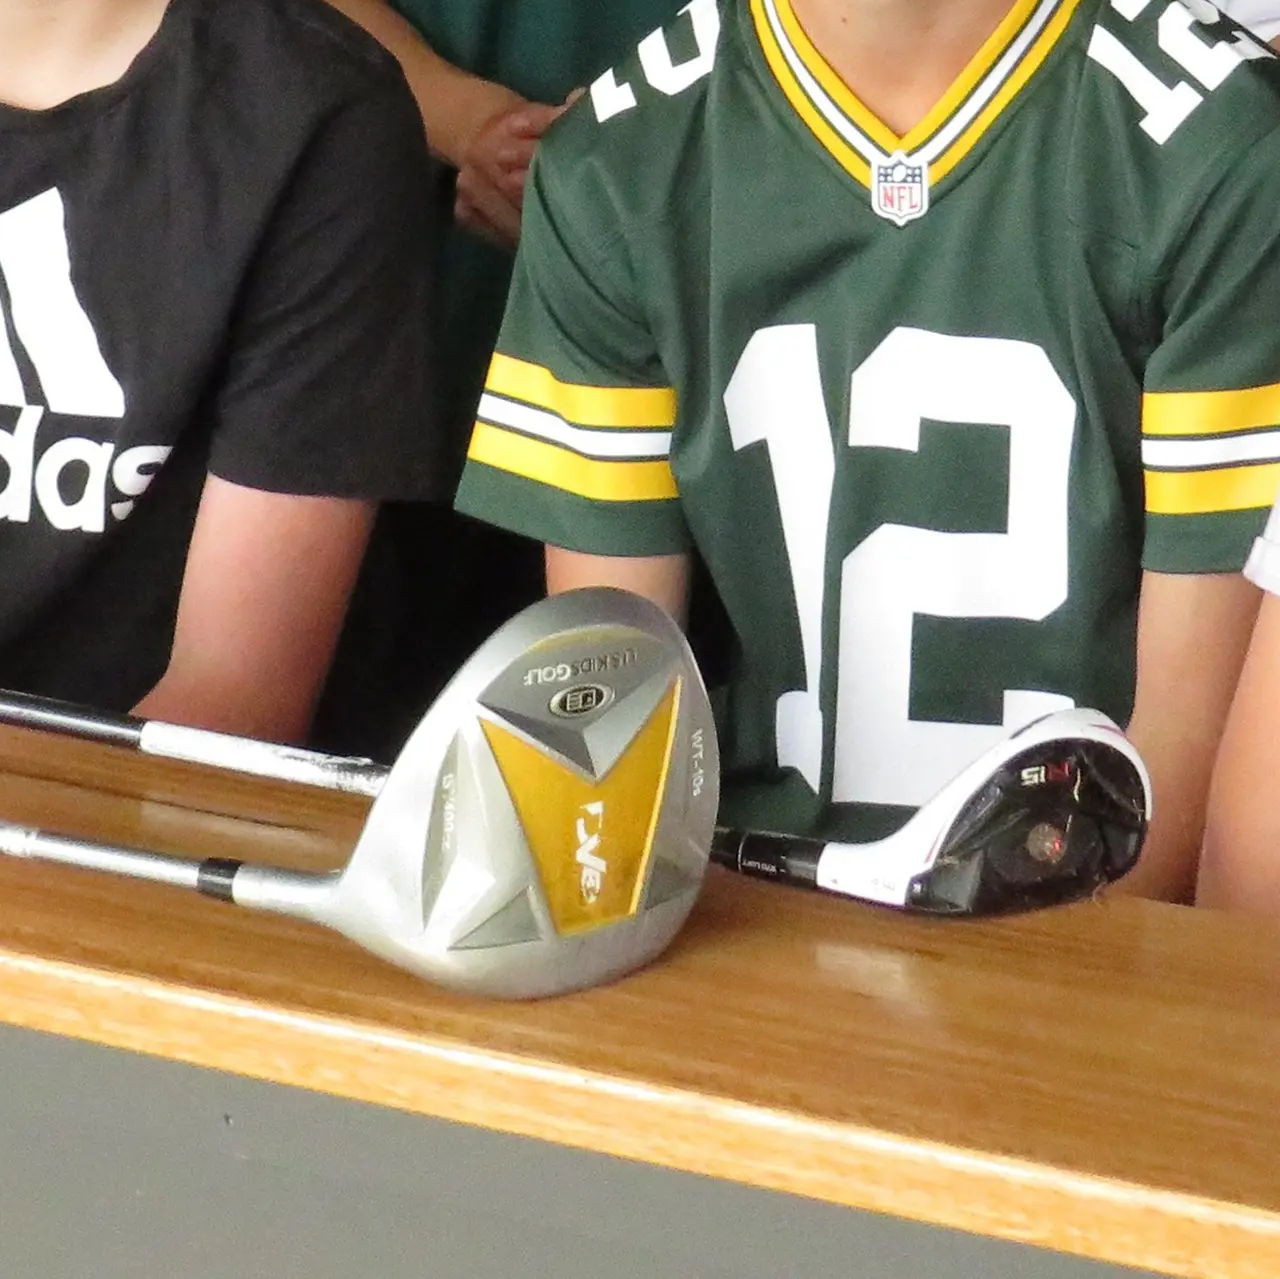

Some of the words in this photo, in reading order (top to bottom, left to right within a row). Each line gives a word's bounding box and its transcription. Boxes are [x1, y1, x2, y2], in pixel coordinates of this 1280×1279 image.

[882, 186, 919, 212] NFL
[723, 323, 1077, 806] 12
[523, 663, 571, 687] GOLF
